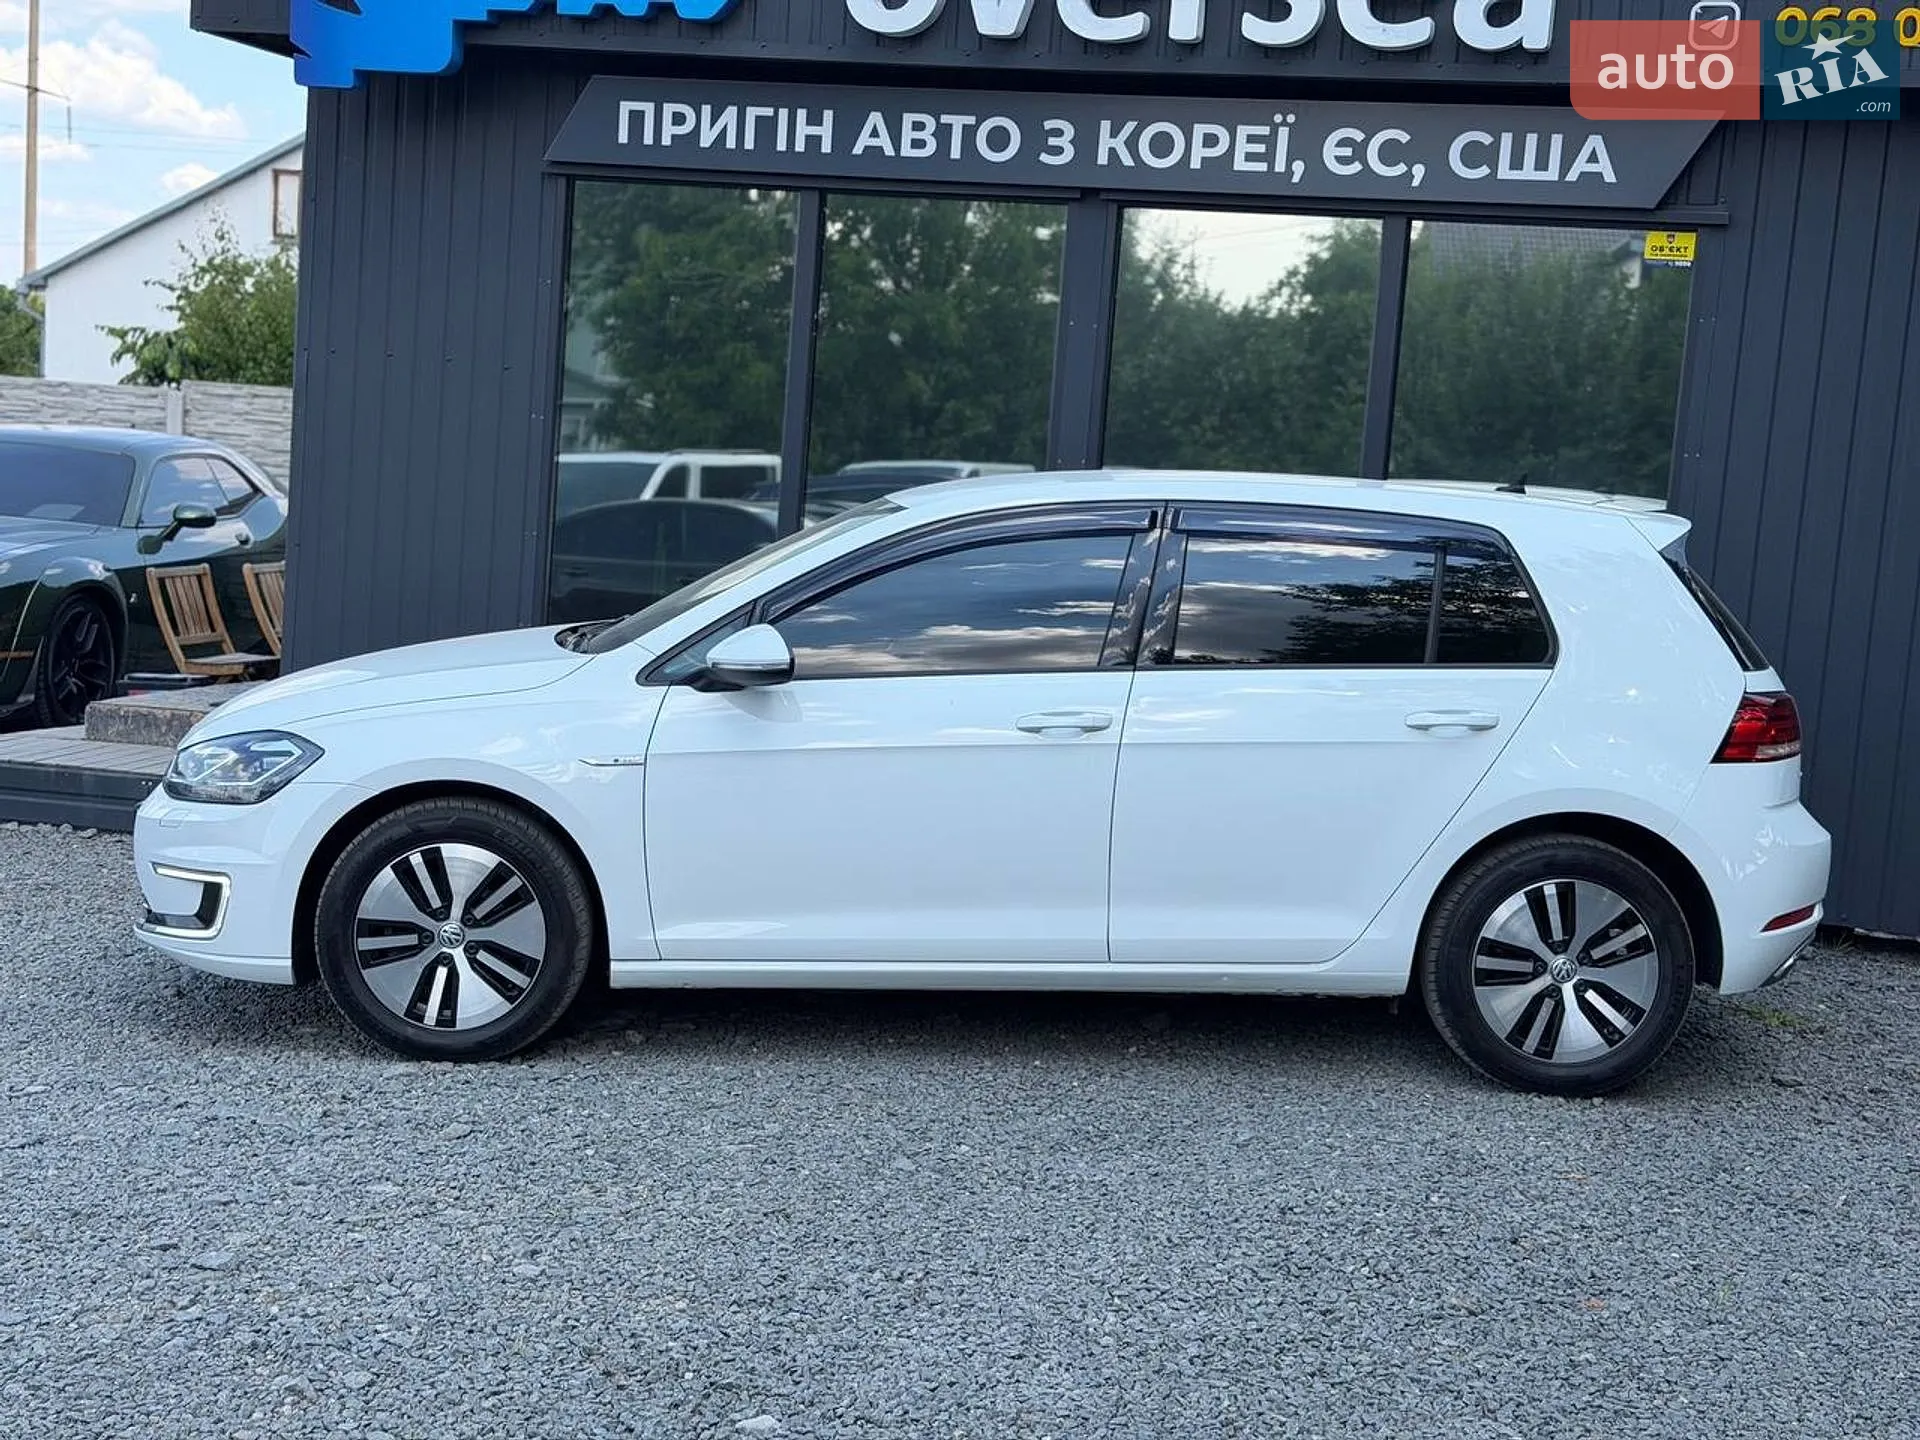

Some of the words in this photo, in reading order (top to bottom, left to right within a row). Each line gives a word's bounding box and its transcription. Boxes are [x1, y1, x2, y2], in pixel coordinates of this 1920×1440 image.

[1775, 6, 1877, 47] 068
[617, 100, 834, 154] ПРИГІН
[851, 111, 1021, 163] АВТО
[1038, 118, 1076, 166] З
[1096, 113, 1305, 183] КОРЕЇ,
[1322, 127, 1426, 187] ЄС,
[1448, 130, 1617, 183] США
